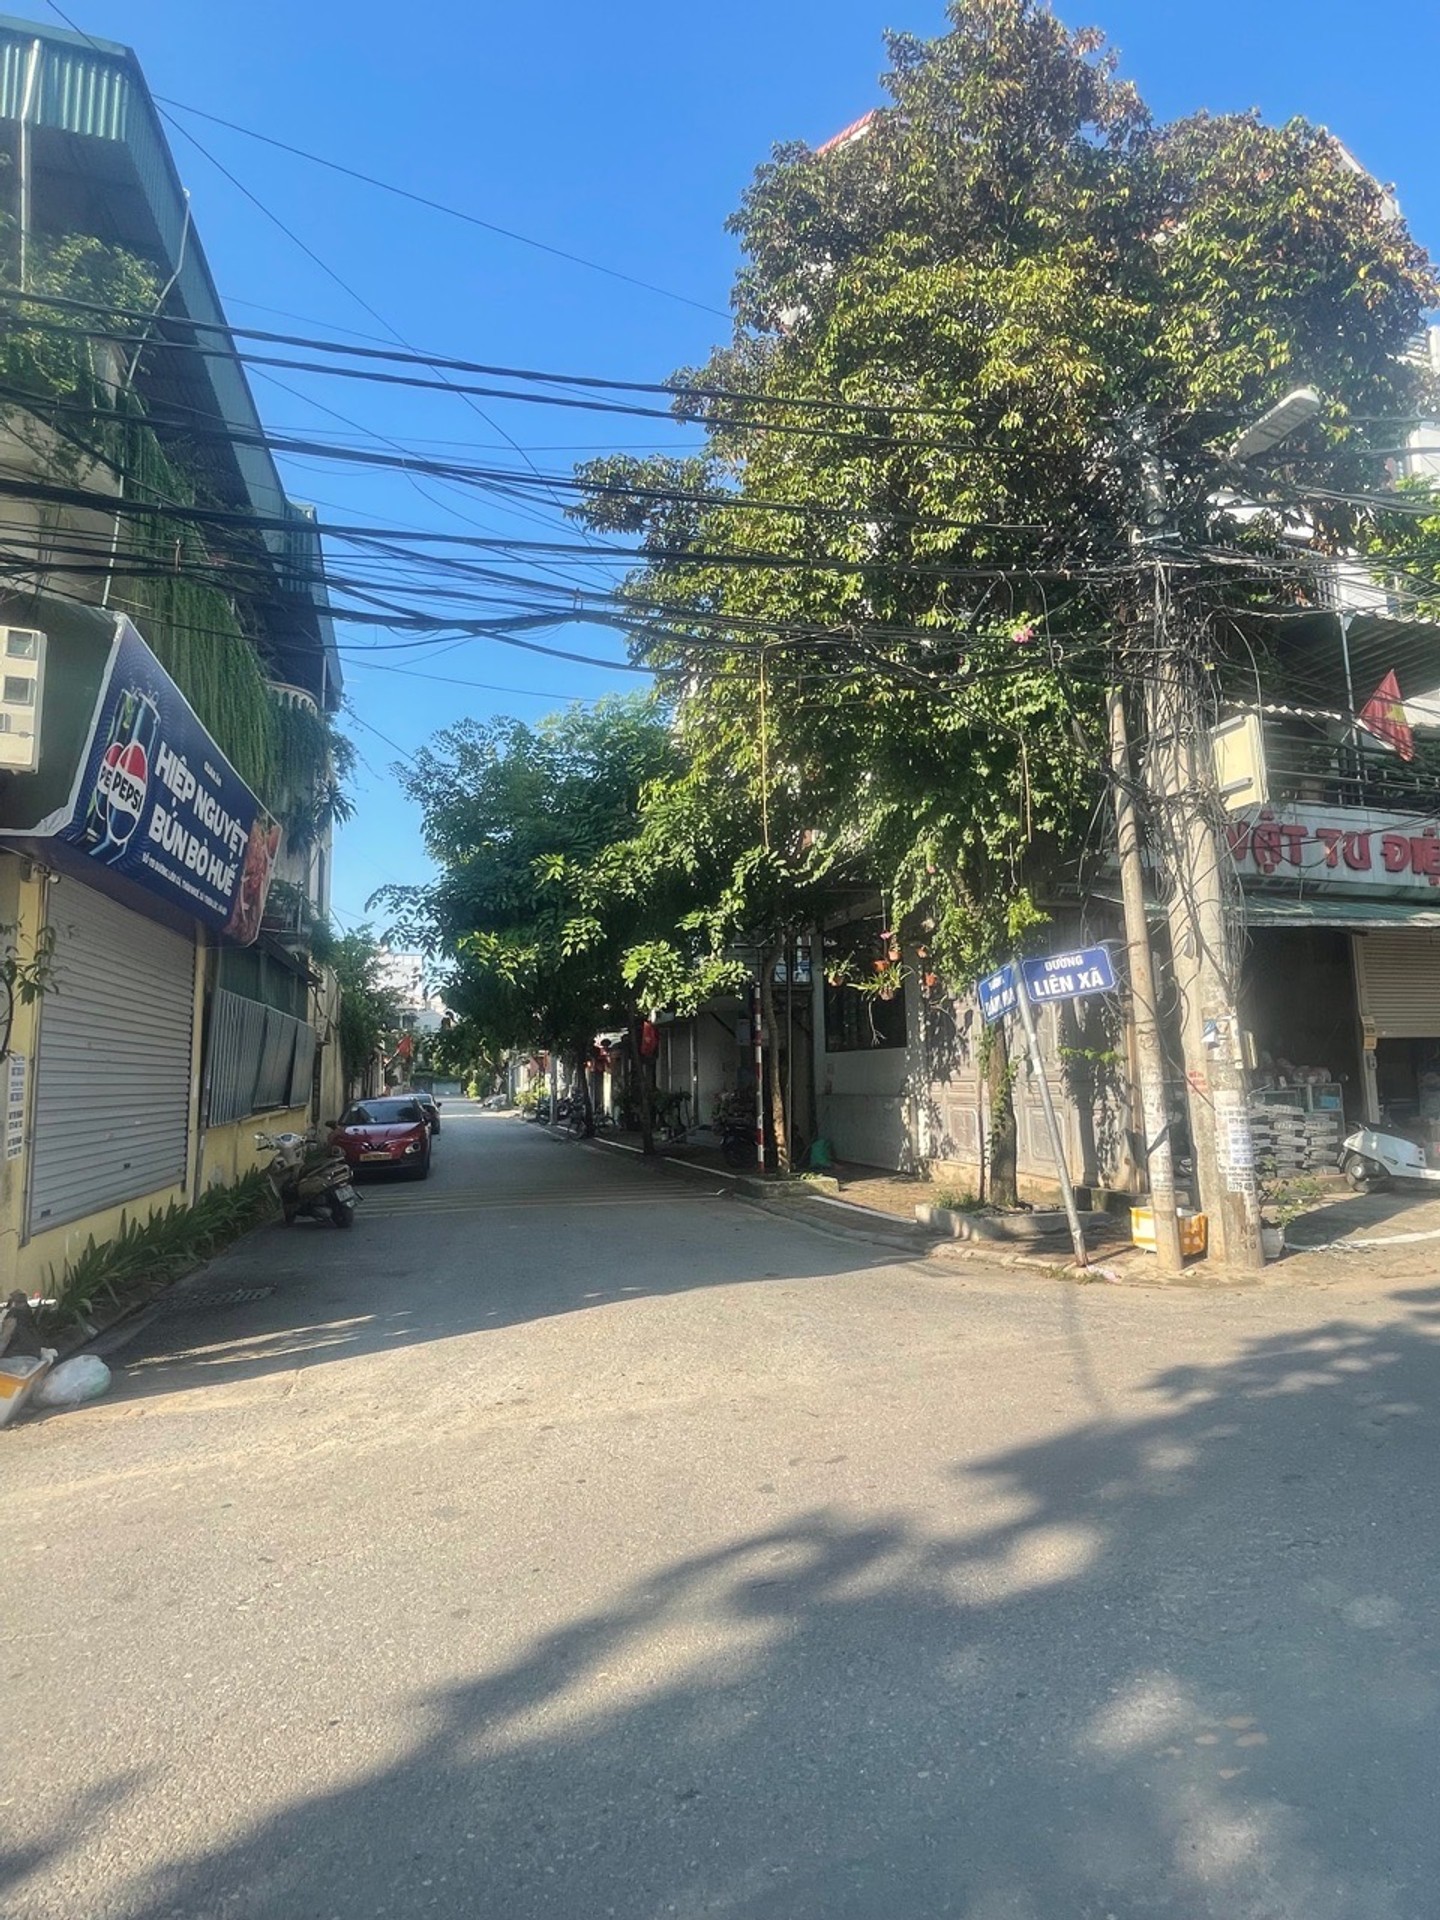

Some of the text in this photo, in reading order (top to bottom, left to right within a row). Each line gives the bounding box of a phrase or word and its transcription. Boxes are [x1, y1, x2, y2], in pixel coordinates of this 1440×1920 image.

[111, 770, 144, 813] PEPSI
[155, 740, 196, 807] HIỆP
[193, 784, 249, 860] NGUYỆT
[148, 803, 187, 862] BÚN
[184, 838, 209, 877] BÒ
[206, 853, 239, 897] HUẾ
[1223, 809, 1309, 874] VẬT
[1033, 973, 1075, 997] LIÊN
[1077, 966, 1105, 990] XÃ
